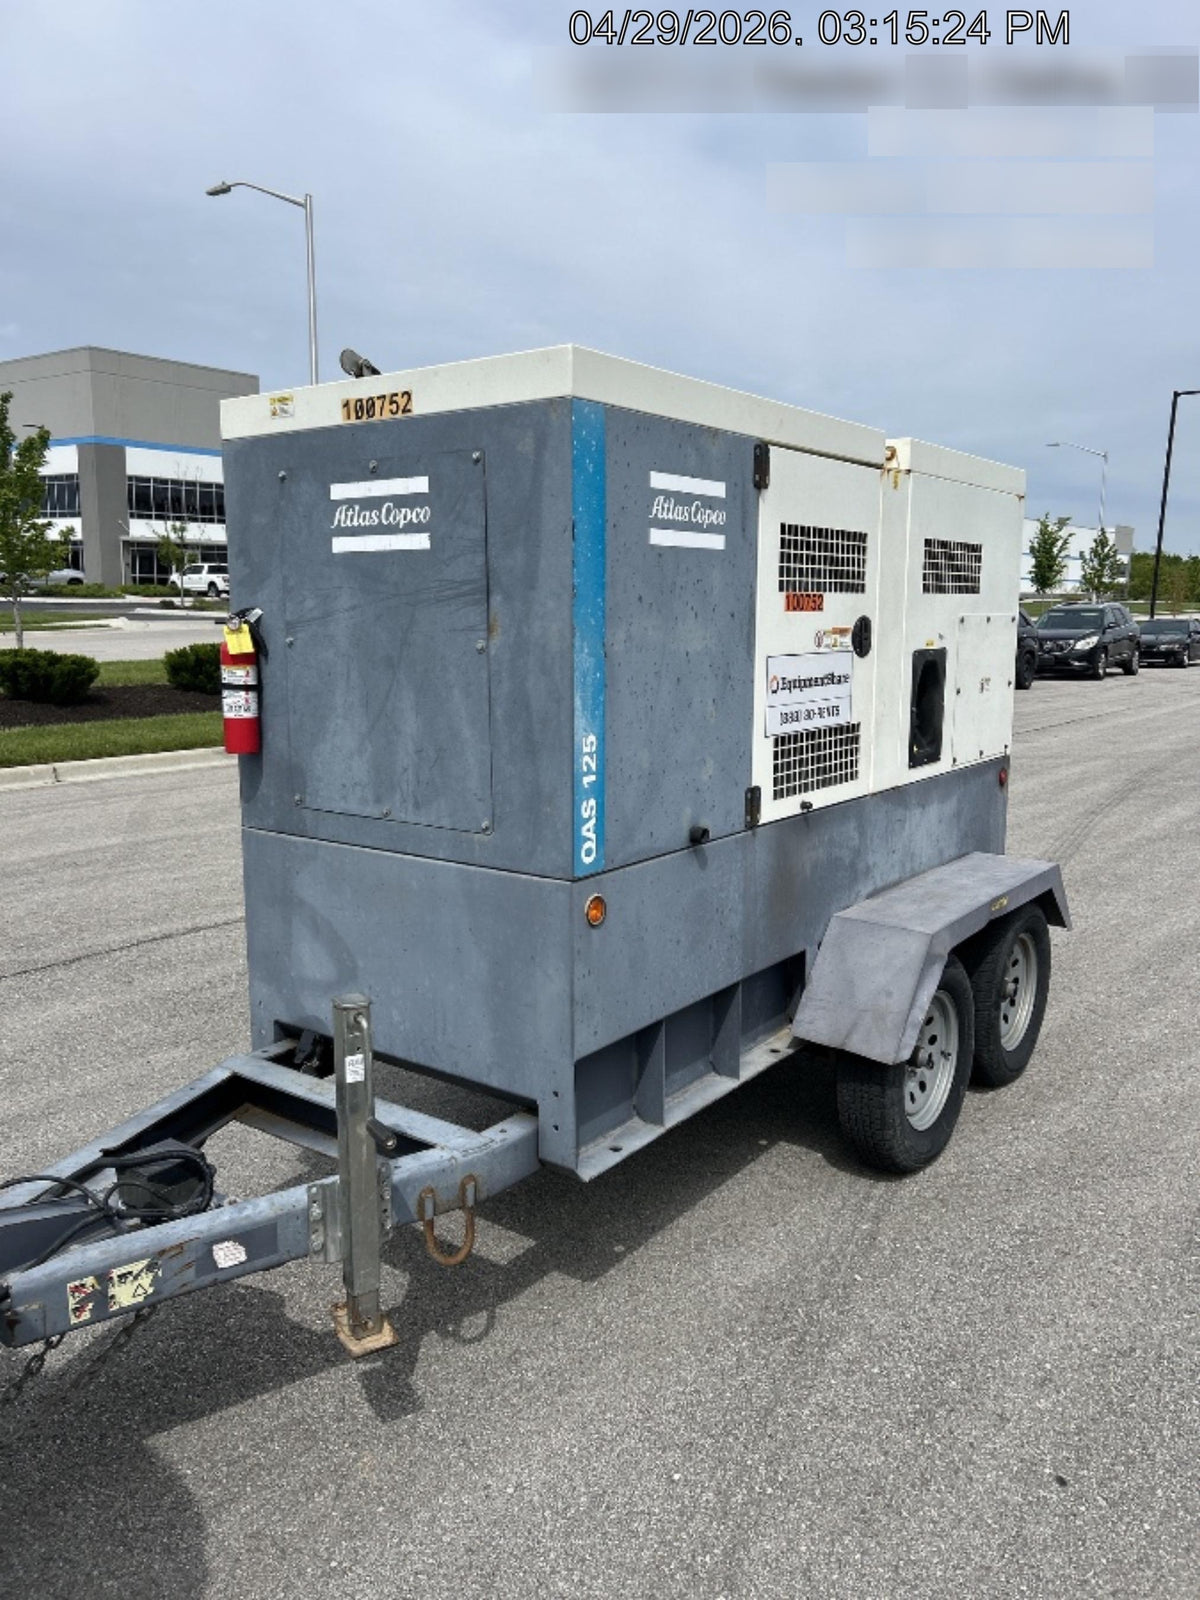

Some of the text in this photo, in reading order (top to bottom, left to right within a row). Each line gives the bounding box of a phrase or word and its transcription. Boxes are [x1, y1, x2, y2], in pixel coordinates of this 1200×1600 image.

[342, 390, 412, 421] 100752
[330, 502, 431, 529] Atlas Copco
[648, 495, 727, 529] Atlas Copco
[785, 592, 824, 611] 100752
[581, 733, 598, 865] QAS 125
